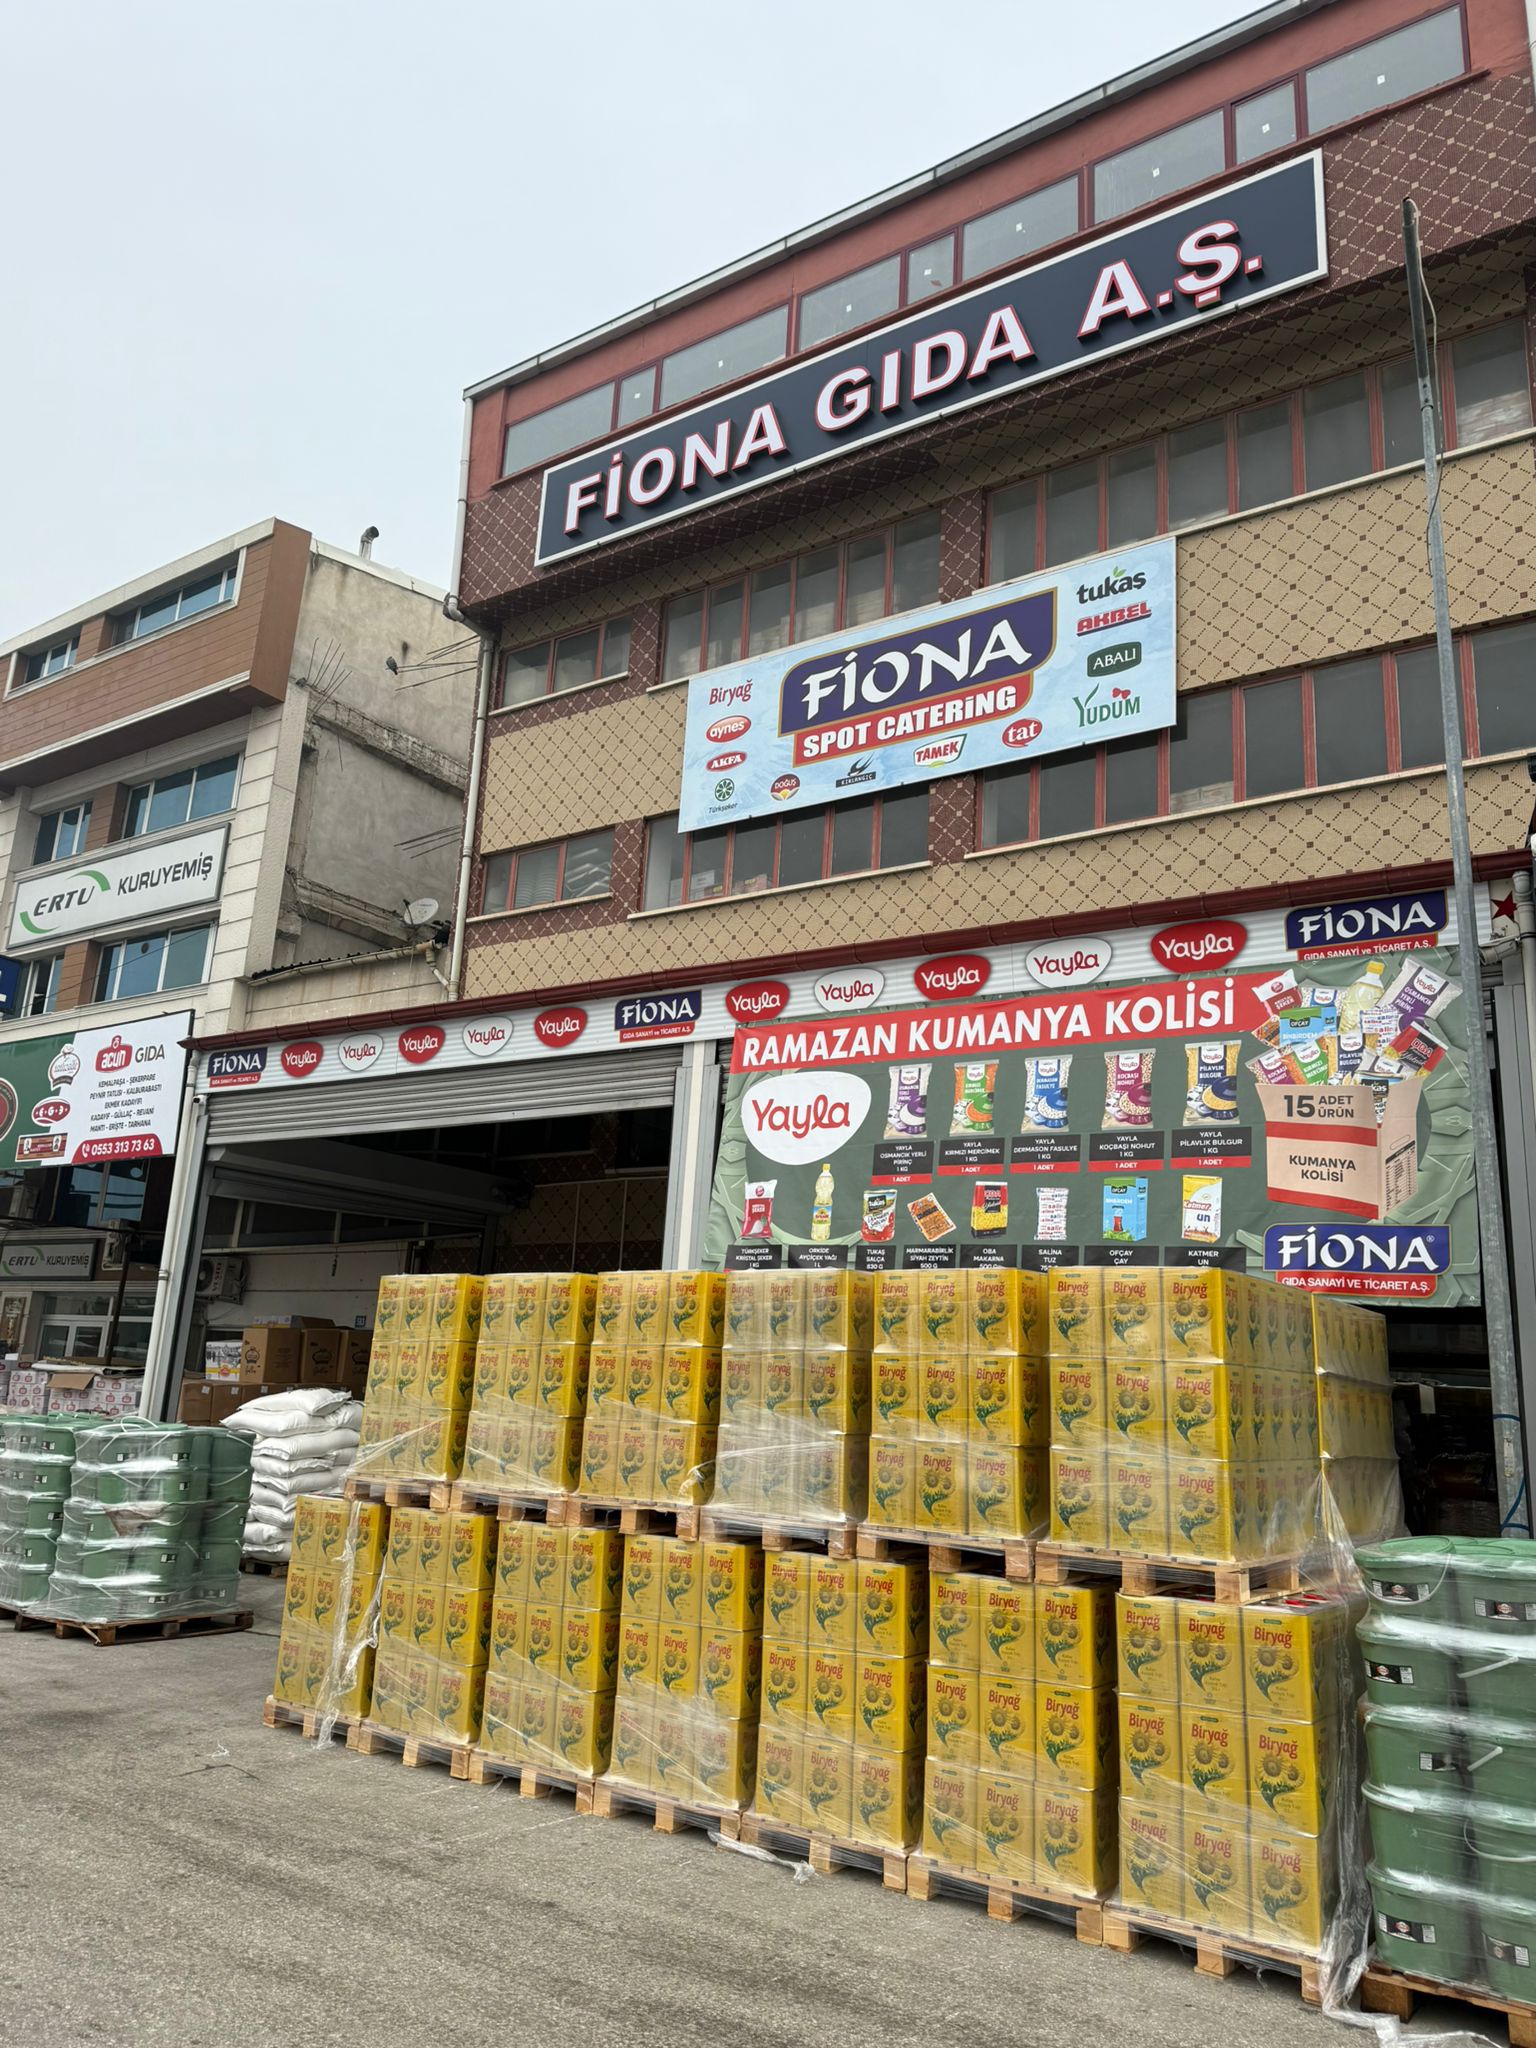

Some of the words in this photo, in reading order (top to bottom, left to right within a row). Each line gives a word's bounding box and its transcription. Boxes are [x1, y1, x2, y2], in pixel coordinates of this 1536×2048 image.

[563, 402, 788, 536] FİONA
[815, 304, 1035, 432] GIDA
[1077, 219, 1264, 339] A.Ş.
[1077, 601, 1151, 633] AKBEL
[1093, 648, 1136, 670] ABALI
[801, 619, 1032, 721] FİONA
[709, 679, 753, 706] Biryağ
[710, 720, 745, 738] aynes
[803, 721, 871, 757] SPOT
[1007, 723, 1038, 743] tat
[710, 754, 742, 768] AKFA
[915, 741, 959, 763] TAMEK
[33, 885, 95, 917] ERTU
[117, 852, 214, 896] KURUYEMİŞ
[1298, 901, 1436, 943] FİONA
[1159, 933, 1234, 961] Yayla
[1327, 948, 1360, 958] SANAYİ
[1373, 941, 1412, 954] TİCARET
[1033, 950, 1100, 976] Yayla
[921, 967, 981, 990] Yayla
[820, 979, 875, 1003] Yayla
[622, 998, 695, 1026] FİONA
[731, 991, 781, 1014] Yayla
[539, 1017, 581, 1037] Yayla
[742, 1022, 898, 1067] RAMAZAN
[908, 1002, 1092, 1052] KUMANYA
[1104, 977, 1234, 1035] KOLİSİ
[402, 1034, 439, 1053] Yayla
[468, 1026, 506, 1046] Yayla
[101, 1052, 126, 1069] acun
[135, 1044, 165, 1063] GIDA
[213, 1052, 262, 1074] FİONA
[285, 1052, 317, 1068] Yayla
[342, 1044, 376, 1061] Yayla
[1283, 1094, 1316, 1118] 15
[1318, 1095, 1354, 1106] ADET
[752, 1094, 850, 1139] Yayla
[1318, 1107, 1355, 1118] ÜRÜN
[91, 1143, 113, 1156] 0553
[114, 1141, 129, 1154] 313
[130, 1140, 142, 1152] 73
[143, 1138, 155, 1151] 63
[1099, 1143, 1129, 1151] KOÇBAŞI
[1179, 1139, 1211, 1147] PİLAVLIK
[1212, 1138, 1243, 1146] BULGUR
[1289, 1154, 1357, 1171] KUMANYA
[1300, 1168, 1344, 1183] KOLİSİ
[1196, 1213, 1211, 1222] un
[1038, 1248, 1062, 1256] SALİNA
[1109, 1250, 1133, 1258] OFÇAY
[1277, 1226, 1439, 1271] FİONA
[8, 1256, 38, 1266] ERTU
[46, 1252, 89, 1269] KURUYEMİŞ
[1198, 1258, 1210, 1266] UN
[1112, 1282, 1146, 1299] Biryağ
[1172, 1282, 1208, 1300] Biryağ
[1282, 1275, 1307, 1287] GIDA
[1308, 1274, 1345, 1289] SANAYİ
[1348, 1279, 1361, 1289] VE
[1363, 1276, 1408, 1291] TİCARET
[1410, 1281, 1430, 1294] A.Ş.
[976, 1369, 1006, 1384] Biryağ
[1059, 1372, 1091, 1391] Biryağ
[1175, 1377, 1211, 1396] Biryağ
[864, 1577, 895, 1596] Biryağ
[1044, 1599, 1078, 1621] Biryağ
[1188, 1618, 1226, 1641] Biryağ
[1254, 1627, 1293, 1649] Biryağ
[864, 1668, 893, 1688] Biryağ
[936, 1680, 966, 1702] Biryağ
[988, 1690, 1020, 1711] Biryağ
[1046, 1698, 1078, 1720] Biryağ
[1128, 1713, 1164, 1736] Biryağ
[1191, 1724, 1228, 1749] Biryağ
[1259, 1735, 1298, 1760] Biryağ
[1261, 1847, 1301, 1874] Biryağ
